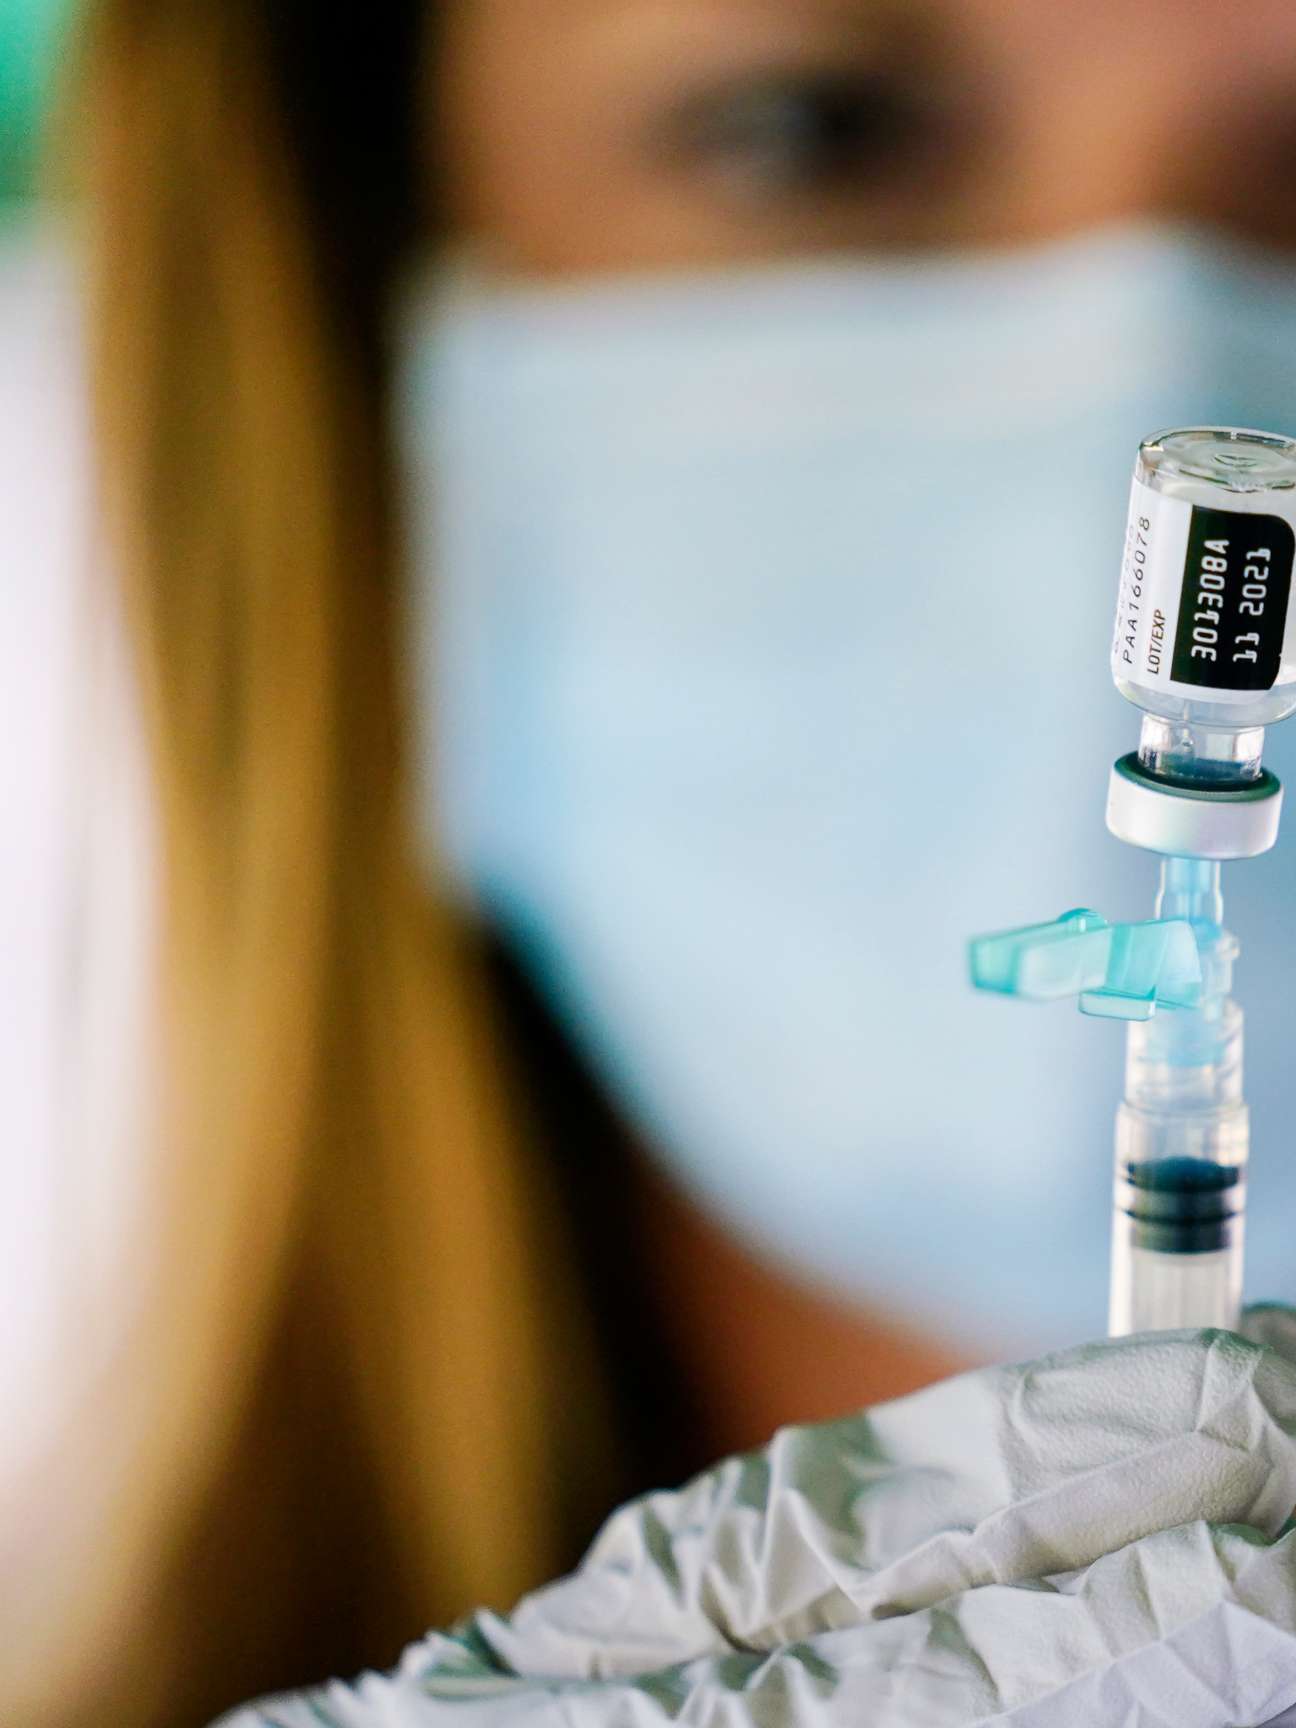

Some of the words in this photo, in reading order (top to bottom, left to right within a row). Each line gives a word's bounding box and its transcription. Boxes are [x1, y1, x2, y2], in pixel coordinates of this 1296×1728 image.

[1123, 516, 1150, 664] PAA166078
[1191, 539, 1230, 662] 301308A
[1240, 548, 1271, 616] 2021
[1147, 609, 1167, 675] LOT/EXP
[1233, 632, 1260, 663] 11
